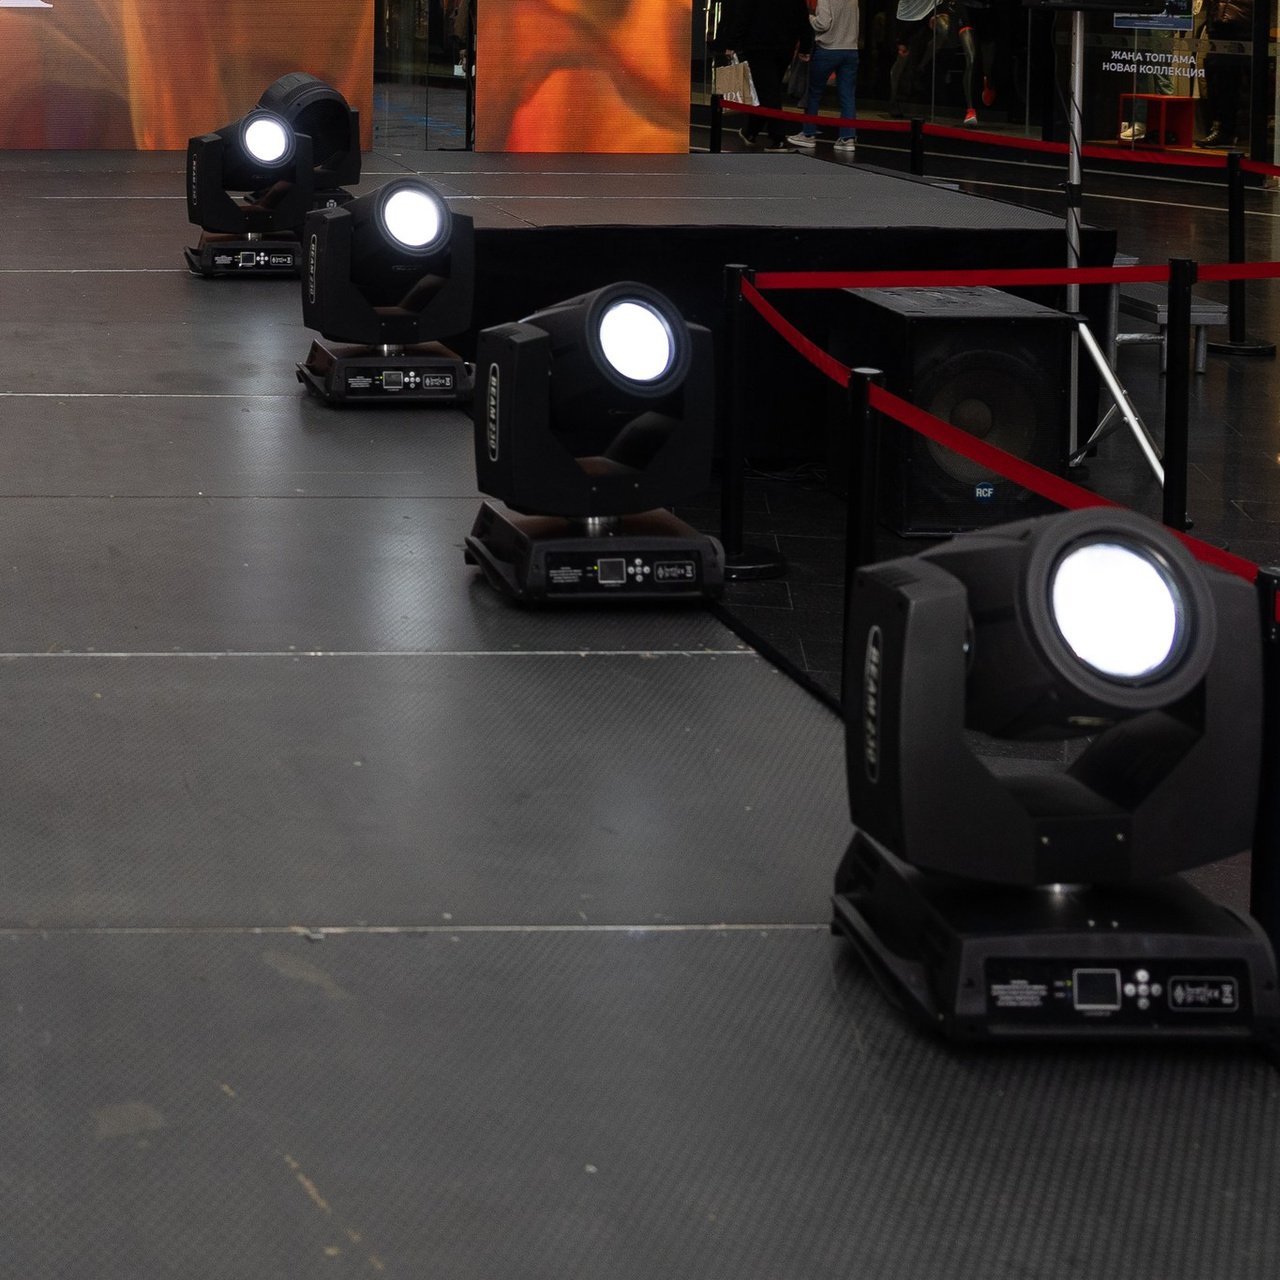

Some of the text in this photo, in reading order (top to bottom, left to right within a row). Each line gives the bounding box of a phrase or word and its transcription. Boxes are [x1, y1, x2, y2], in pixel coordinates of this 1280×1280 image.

[1144, 52, 1197, 65] ТОПТАМА
[1102, 62, 1206, 78] НОВАЯ КОЛЛЕКЦИЯ
[976, 487, 994, 498] RCF
